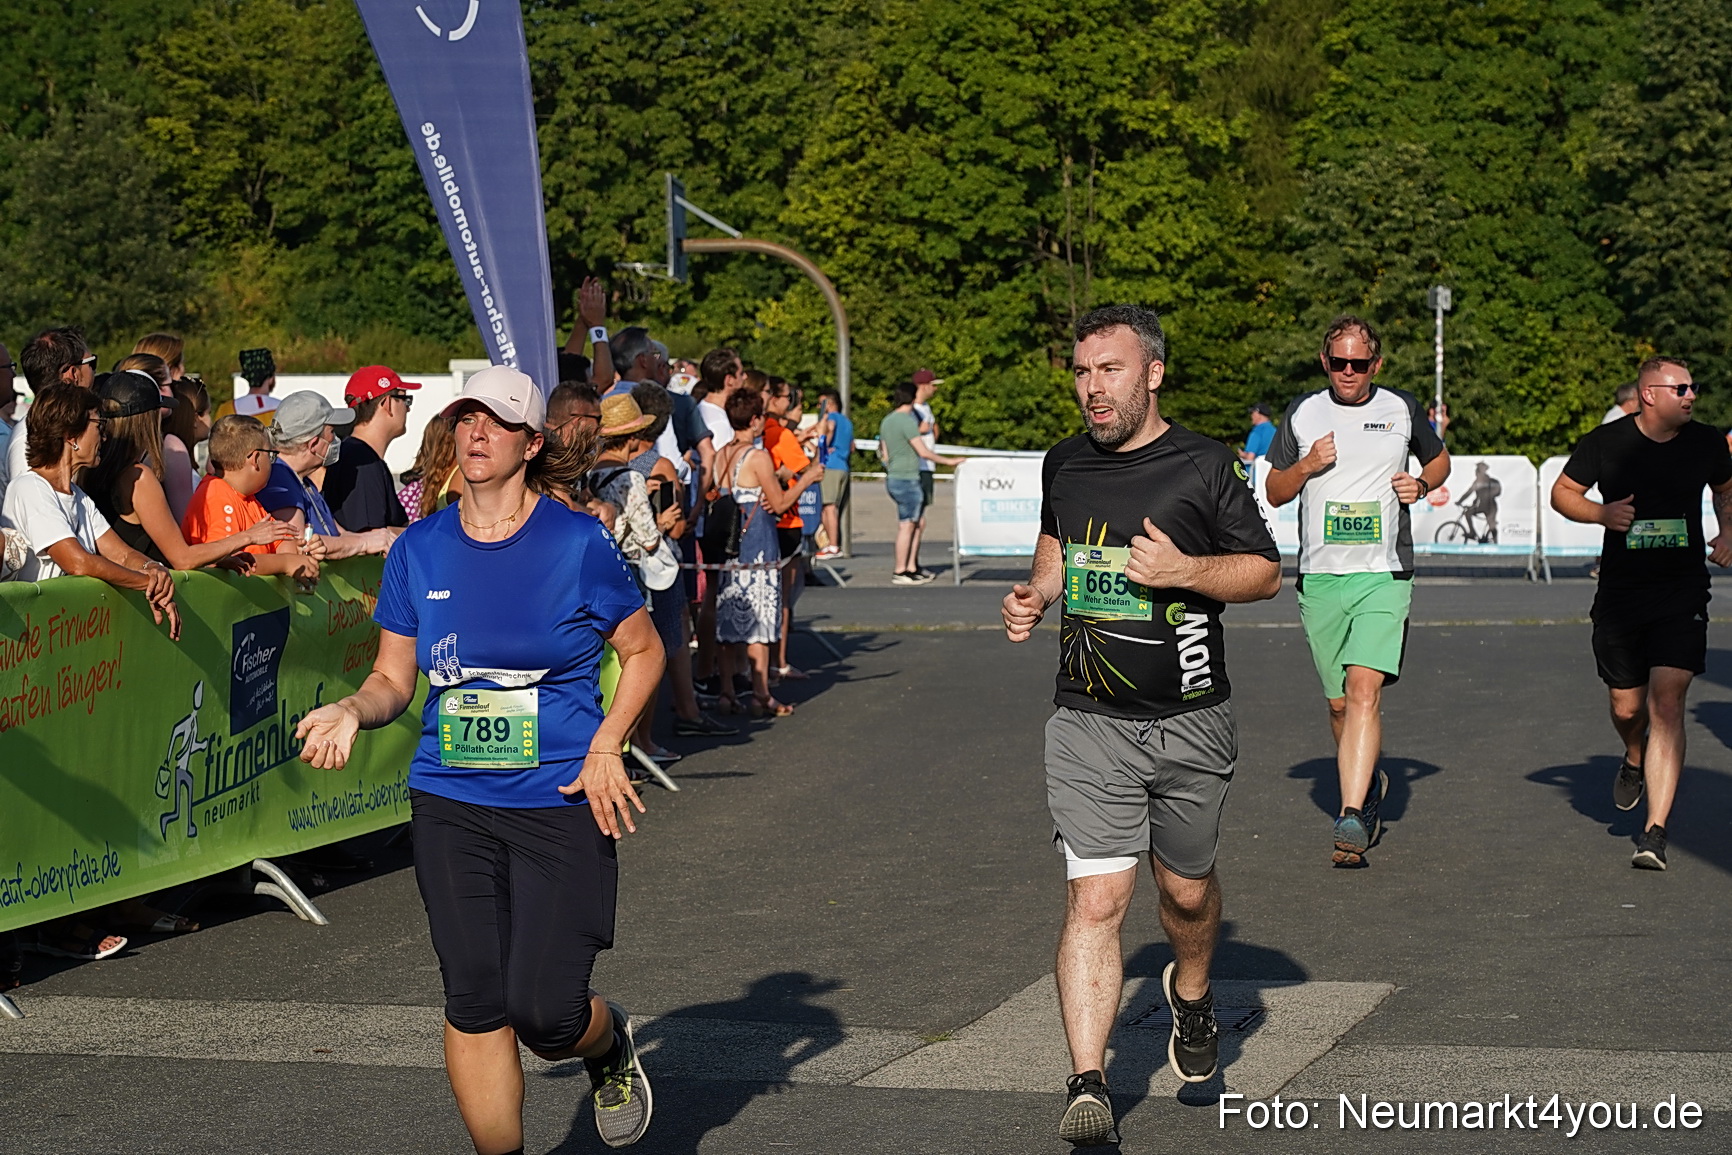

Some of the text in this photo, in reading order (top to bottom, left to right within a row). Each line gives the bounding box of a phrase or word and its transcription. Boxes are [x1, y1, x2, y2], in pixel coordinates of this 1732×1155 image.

[979, 478, 1015, 491] NOW
[1333, 516, 1373, 531] 1662
[1637, 534, 1677, 549] 1734
[426, 590, 451, 600] JAKO
[1071, 575, 1079, 600] RUN
[1086, 570, 1128, 596] 665
[1083, 594, 1131, 606] Wehr Stefan
[1138, 585, 1148, 610] 202
[48, 607, 110, 654] Firmen
[241, 646, 277, 674] Fischer
[343, 625, 380, 674] laufe
[57, 640, 123, 715] länger!
[244, 664, 269, 685] AUTOMOBILE
[460, 702, 490, 711] Firmenlauf
[443, 724, 453, 751] RUN
[459, 716, 511, 743] 789
[522, 720, 533, 757] 2022
[455, 743, 519, 754] Pöllath Carina
[204, 780, 260, 828] neumarkt
[0, 840, 122, 908] auf-oberpfalz.de
